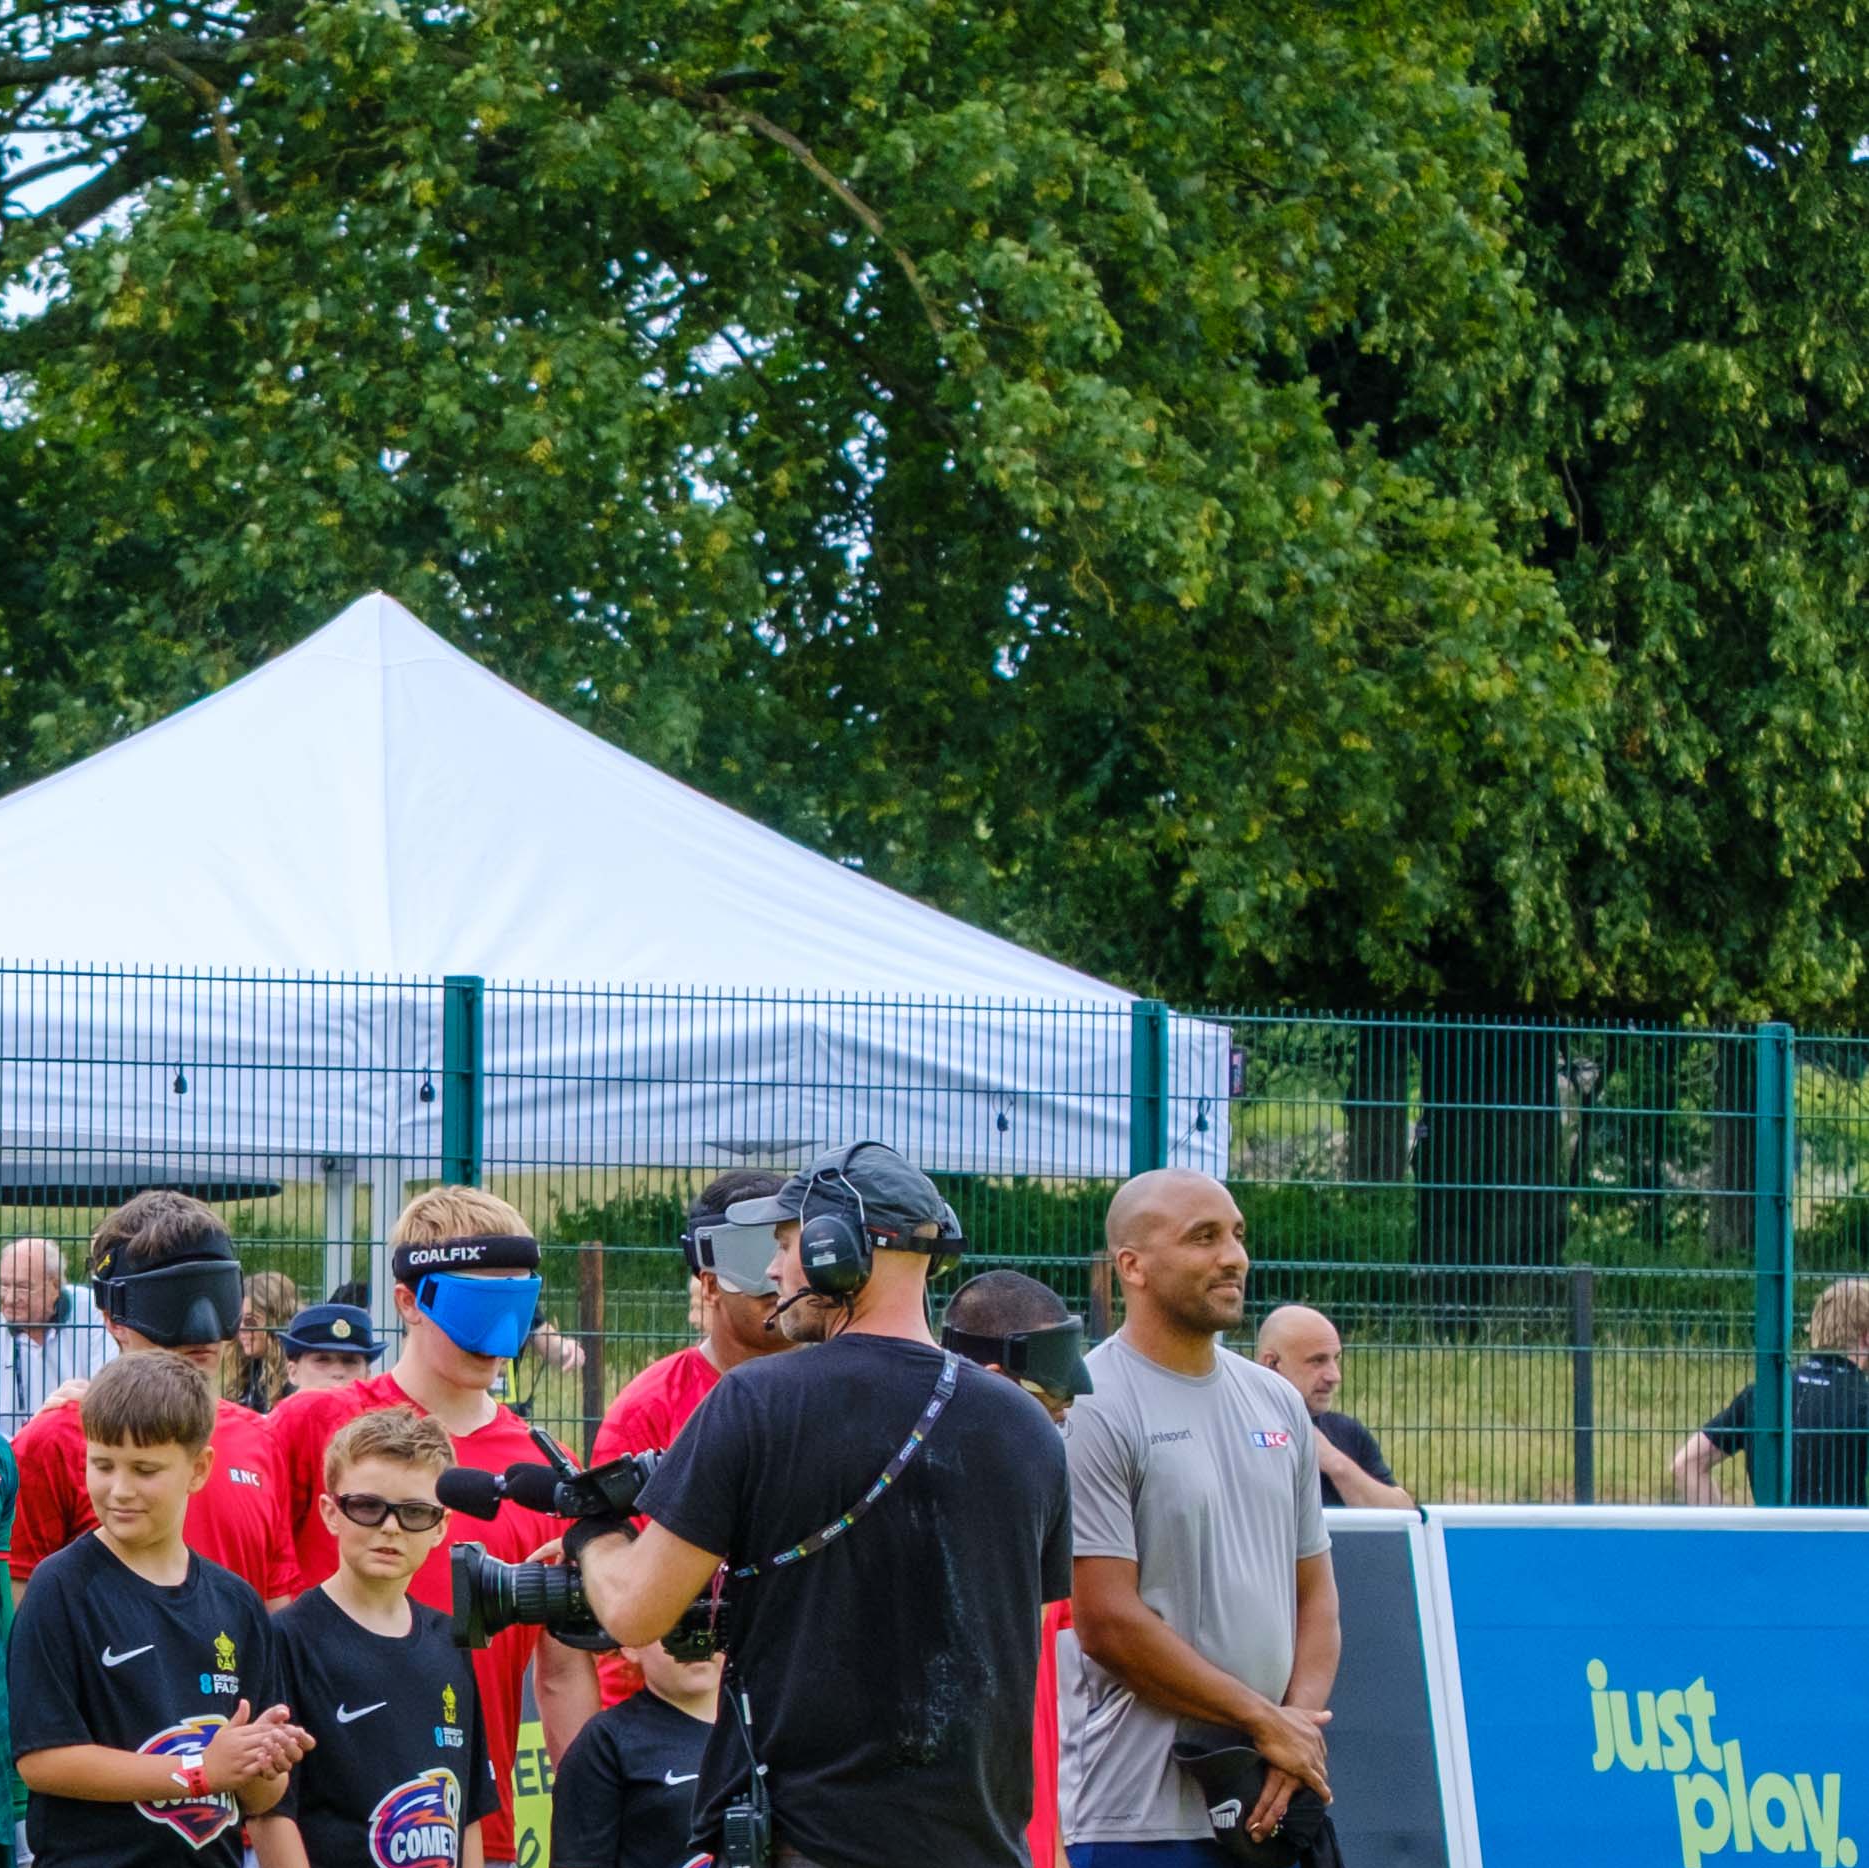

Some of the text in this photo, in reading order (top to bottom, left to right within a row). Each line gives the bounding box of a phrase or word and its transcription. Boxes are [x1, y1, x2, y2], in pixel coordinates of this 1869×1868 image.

[1254, 1433, 1287, 1447] RNC
[230, 1468, 261, 1487] RNC
[1586, 1658, 1723, 1772] just
